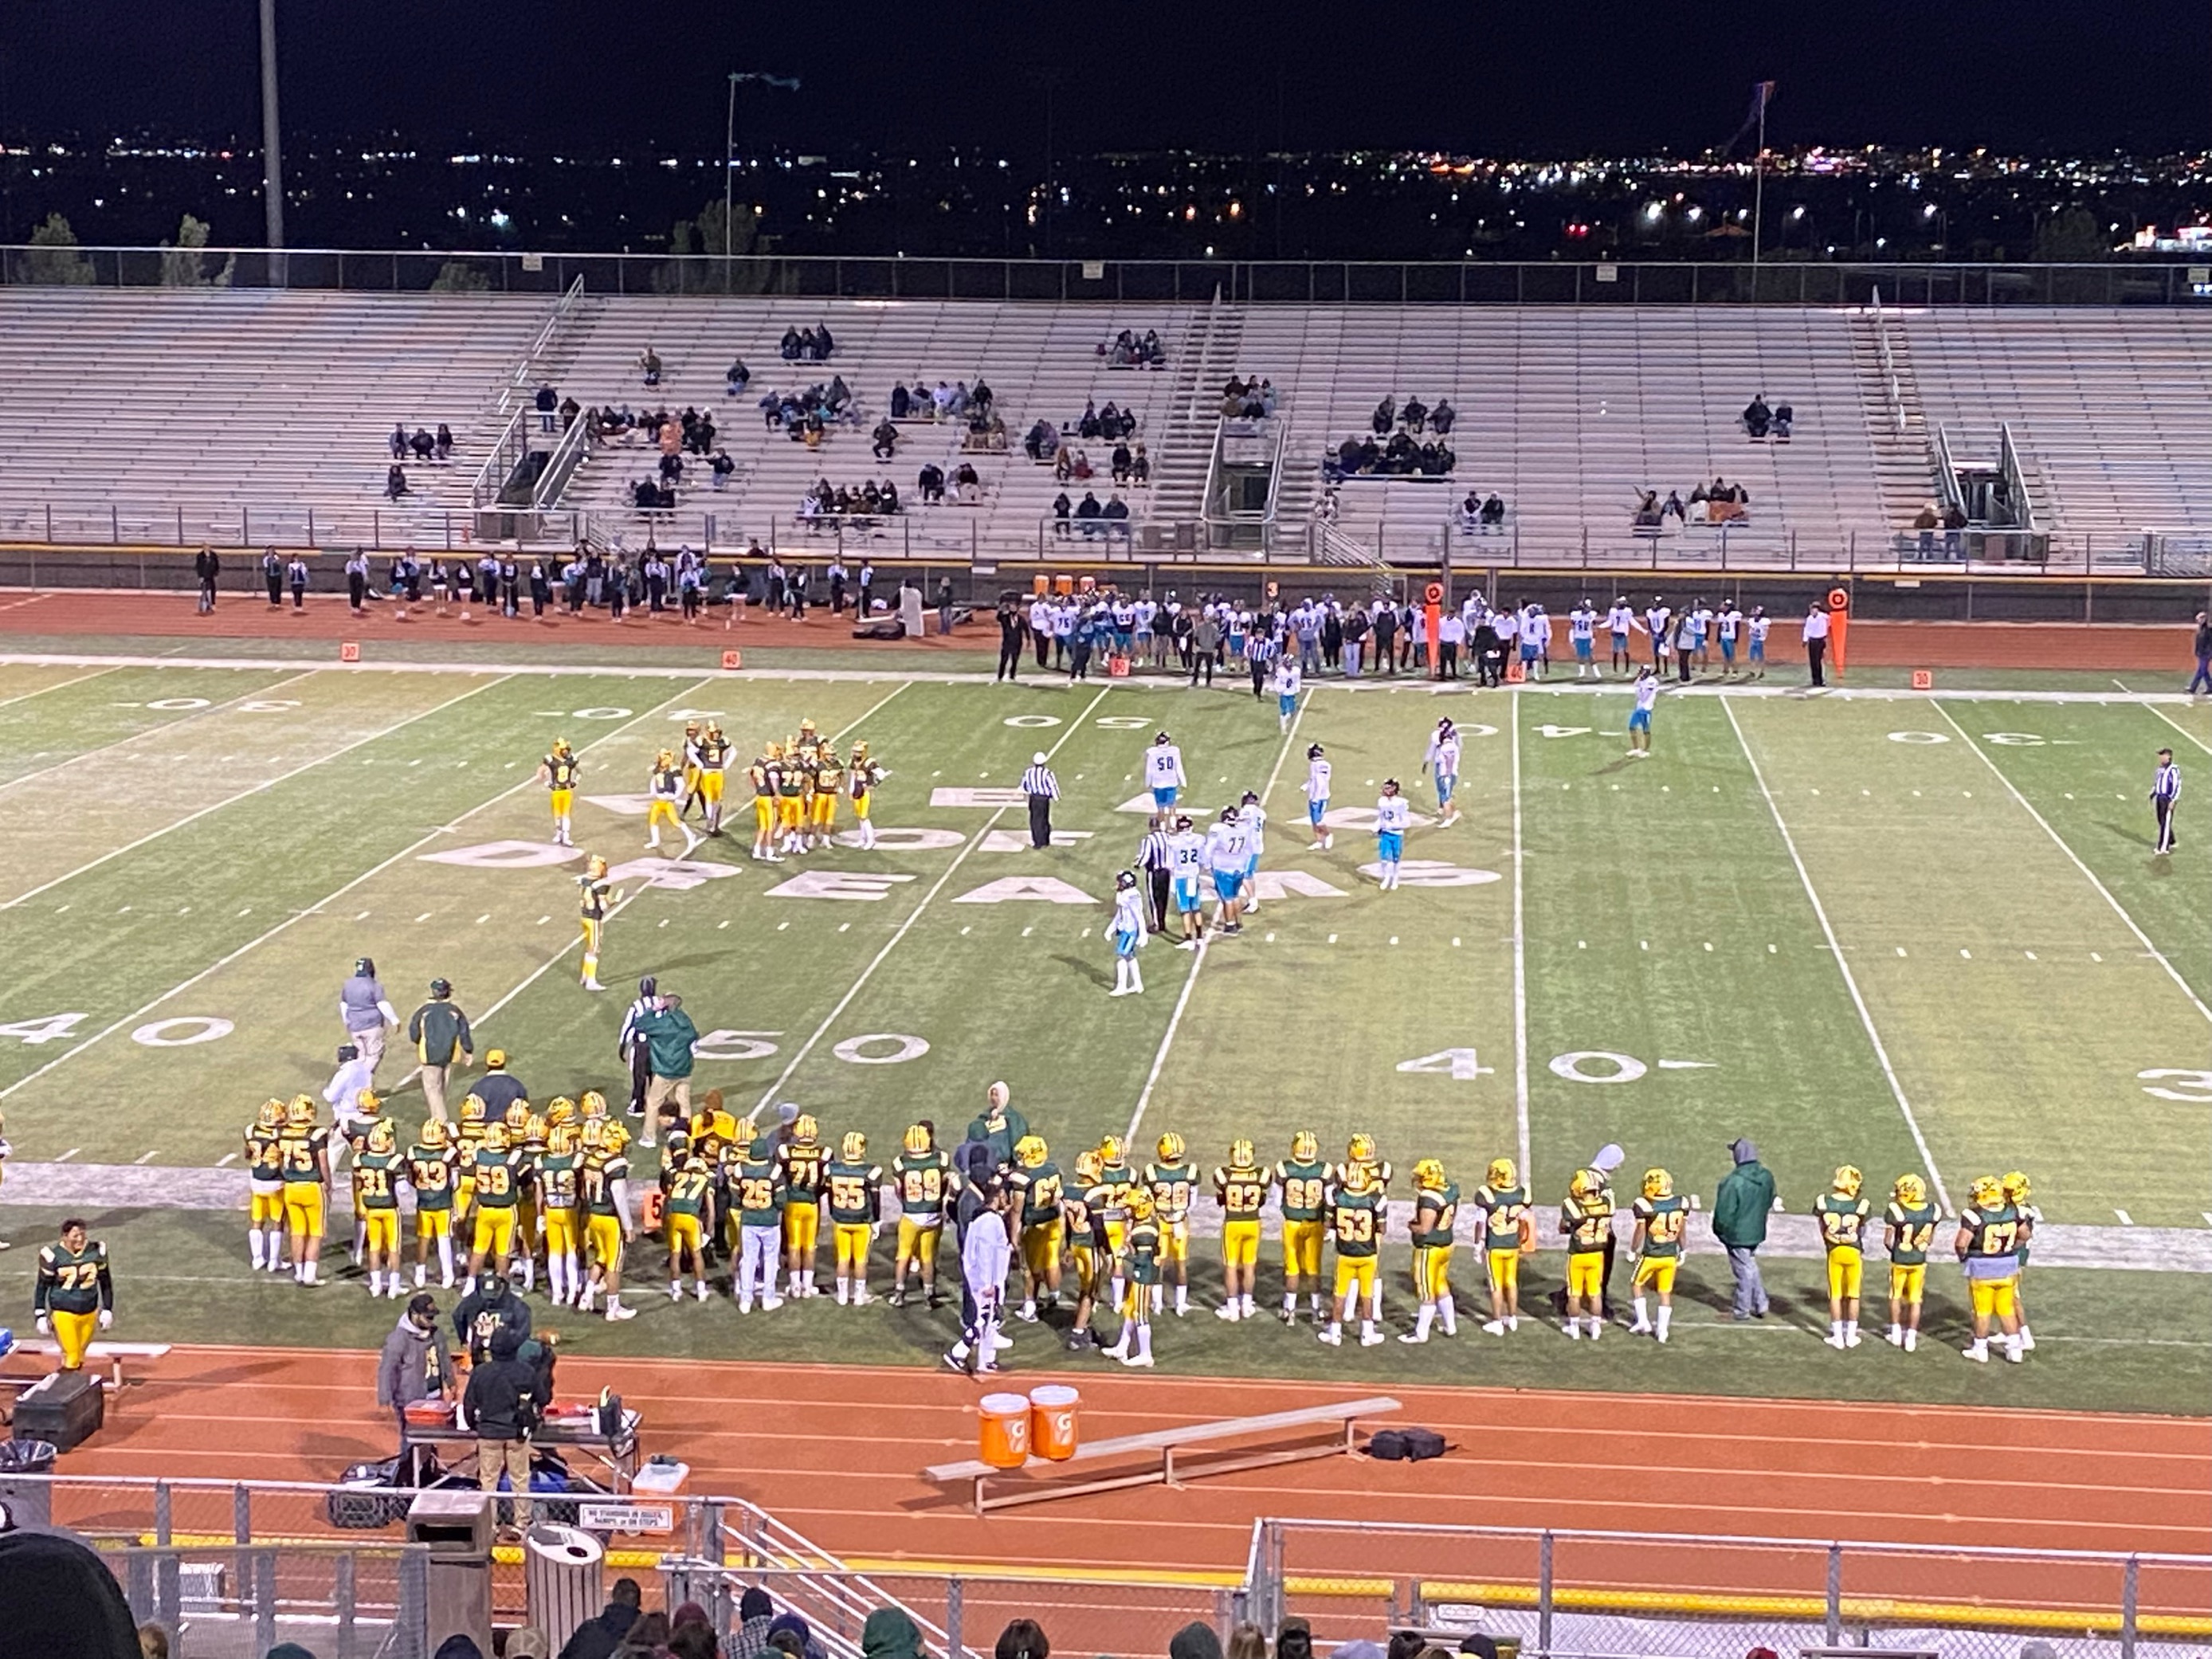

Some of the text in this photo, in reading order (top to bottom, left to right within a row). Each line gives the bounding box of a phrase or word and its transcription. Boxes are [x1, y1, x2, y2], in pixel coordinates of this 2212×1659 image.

[1157, 757, 1174, 771] 50
[1180, 849, 1198, 865] 32
[1228, 837, 1245, 853] 77
[359, 1168, 389, 1196] 31
[671, 1172, 708, 1199] 27
[832, 1177, 865, 1210] 55
[1337, 1207, 1373, 1241] 53
[1983, 1222, 2018, 1255] 67
